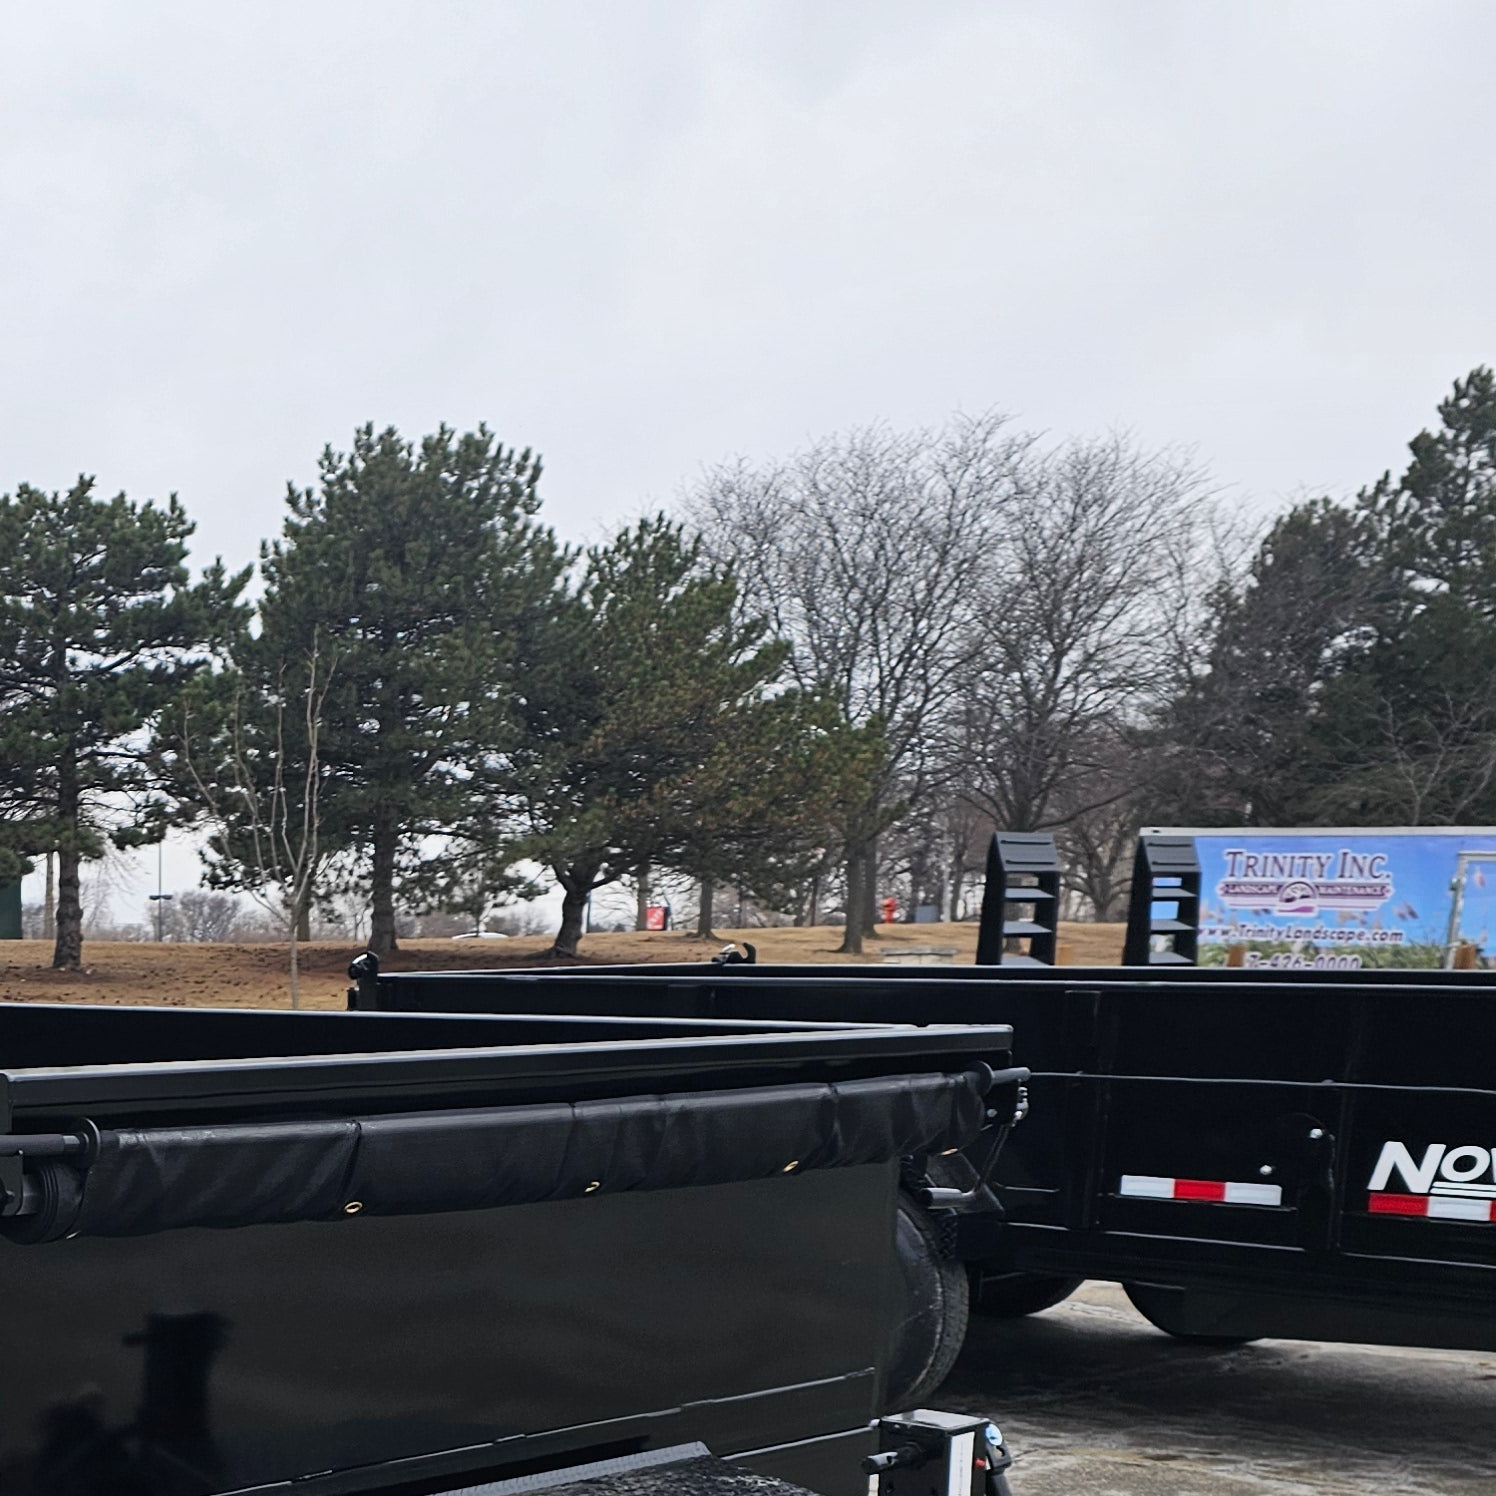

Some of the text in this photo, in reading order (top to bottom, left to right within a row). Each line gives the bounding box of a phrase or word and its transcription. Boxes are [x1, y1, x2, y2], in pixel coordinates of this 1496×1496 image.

[1226, 851, 1391, 879] TRINITY INC.
[1367, 1141, 1496, 1193] NO
